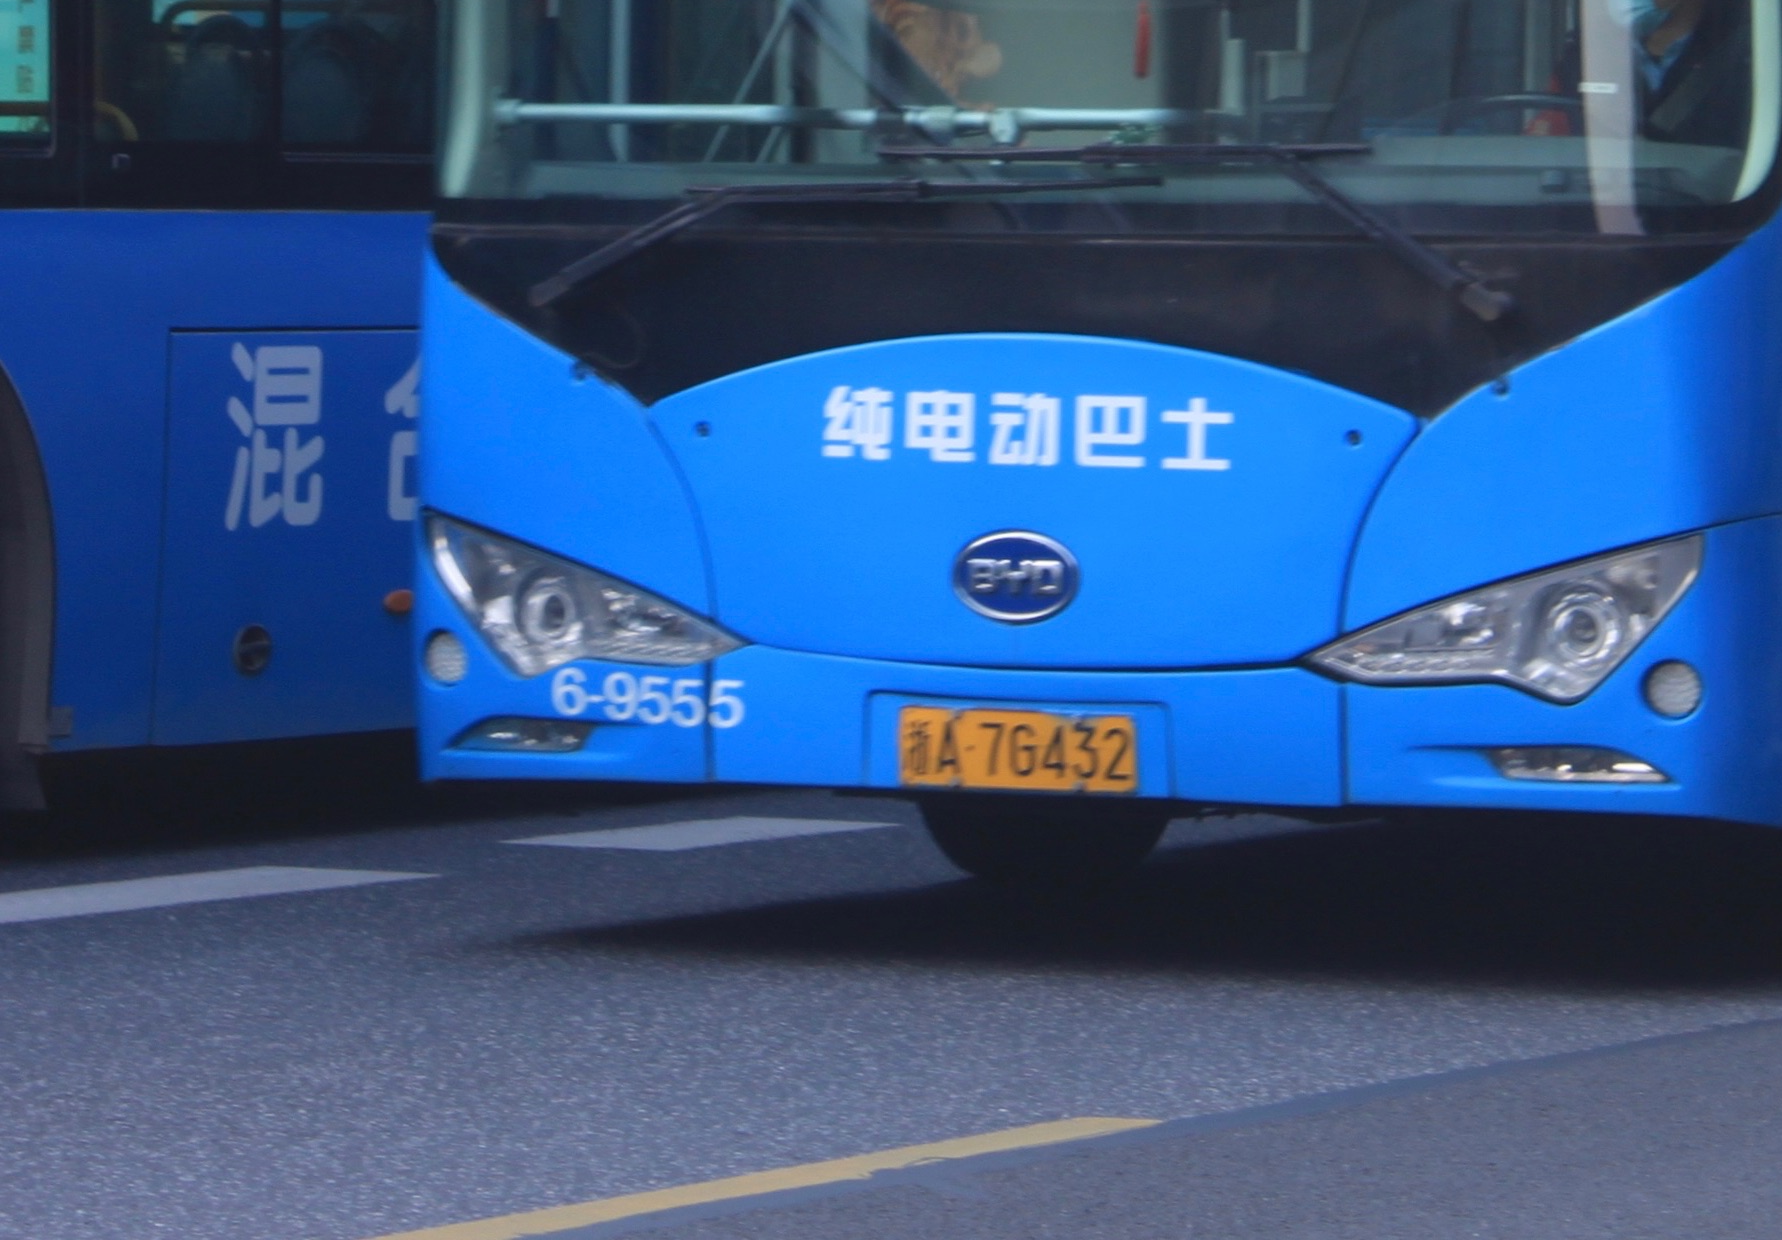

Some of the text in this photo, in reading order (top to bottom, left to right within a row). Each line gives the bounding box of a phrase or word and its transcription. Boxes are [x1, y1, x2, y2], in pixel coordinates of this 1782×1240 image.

[821, 385, 1234, 471] 纯电动巴士
[966, 557, 1064, 596] BYD
[552, 666, 746, 729] 6-9555
